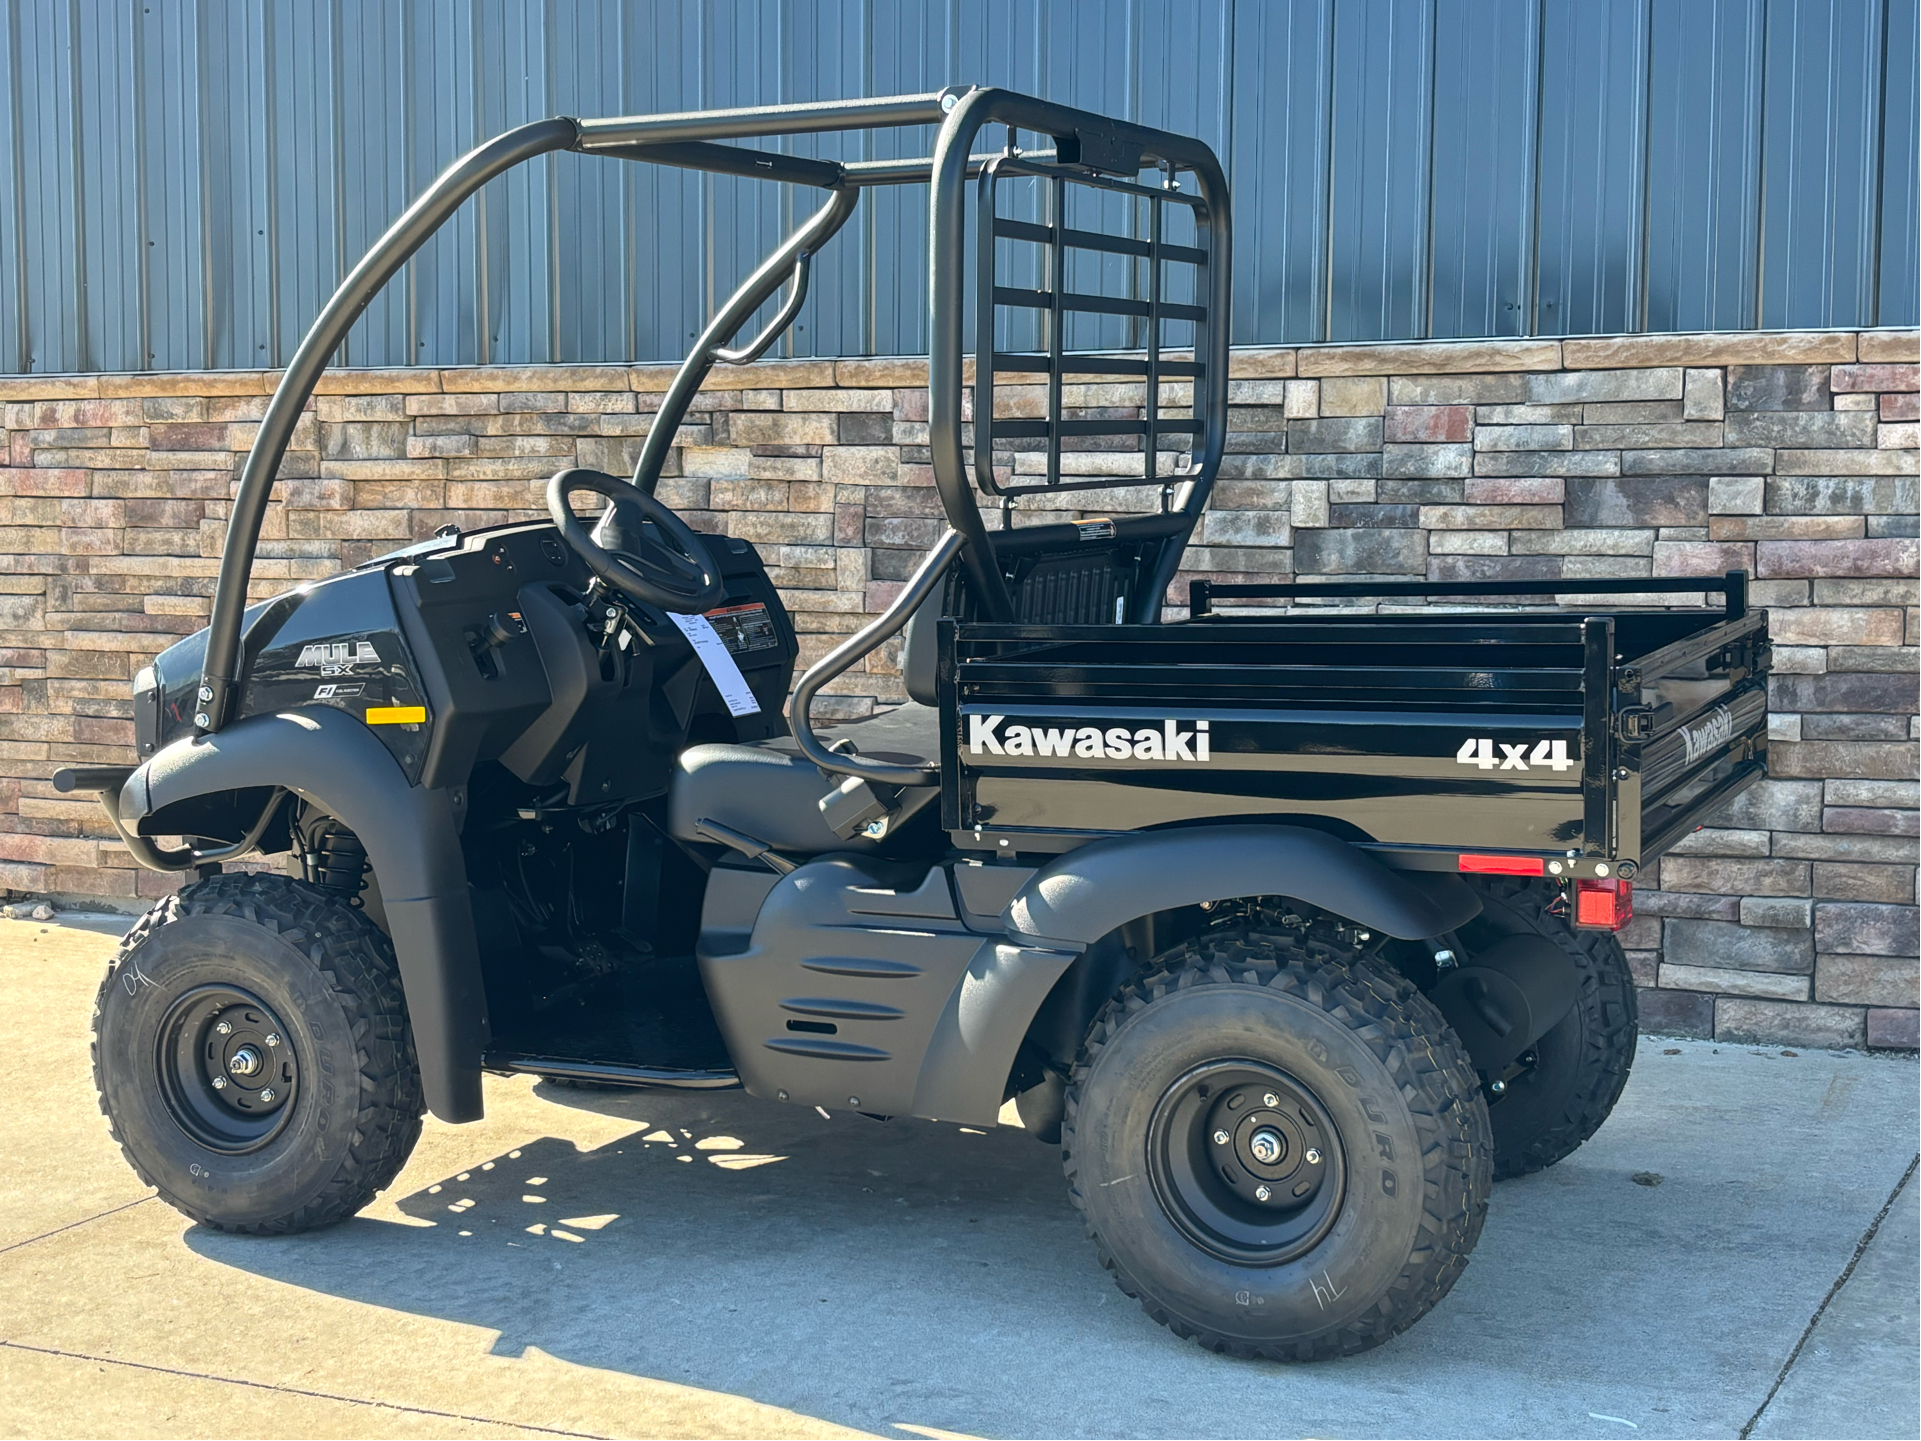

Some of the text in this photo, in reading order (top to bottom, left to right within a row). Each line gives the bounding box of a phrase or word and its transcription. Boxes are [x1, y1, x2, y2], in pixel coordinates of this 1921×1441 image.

[295, 641, 382, 668] MULE
[321, 664, 355, 677] SX
[969, 714, 1210, 762] Kawasaki
[1456, 738, 1574, 772] 4x4
[1677, 703, 1732, 766] Kawasaki
[309, 1020, 336, 1134] DURO
[1334, 1065, 1399, 1198] DURO
